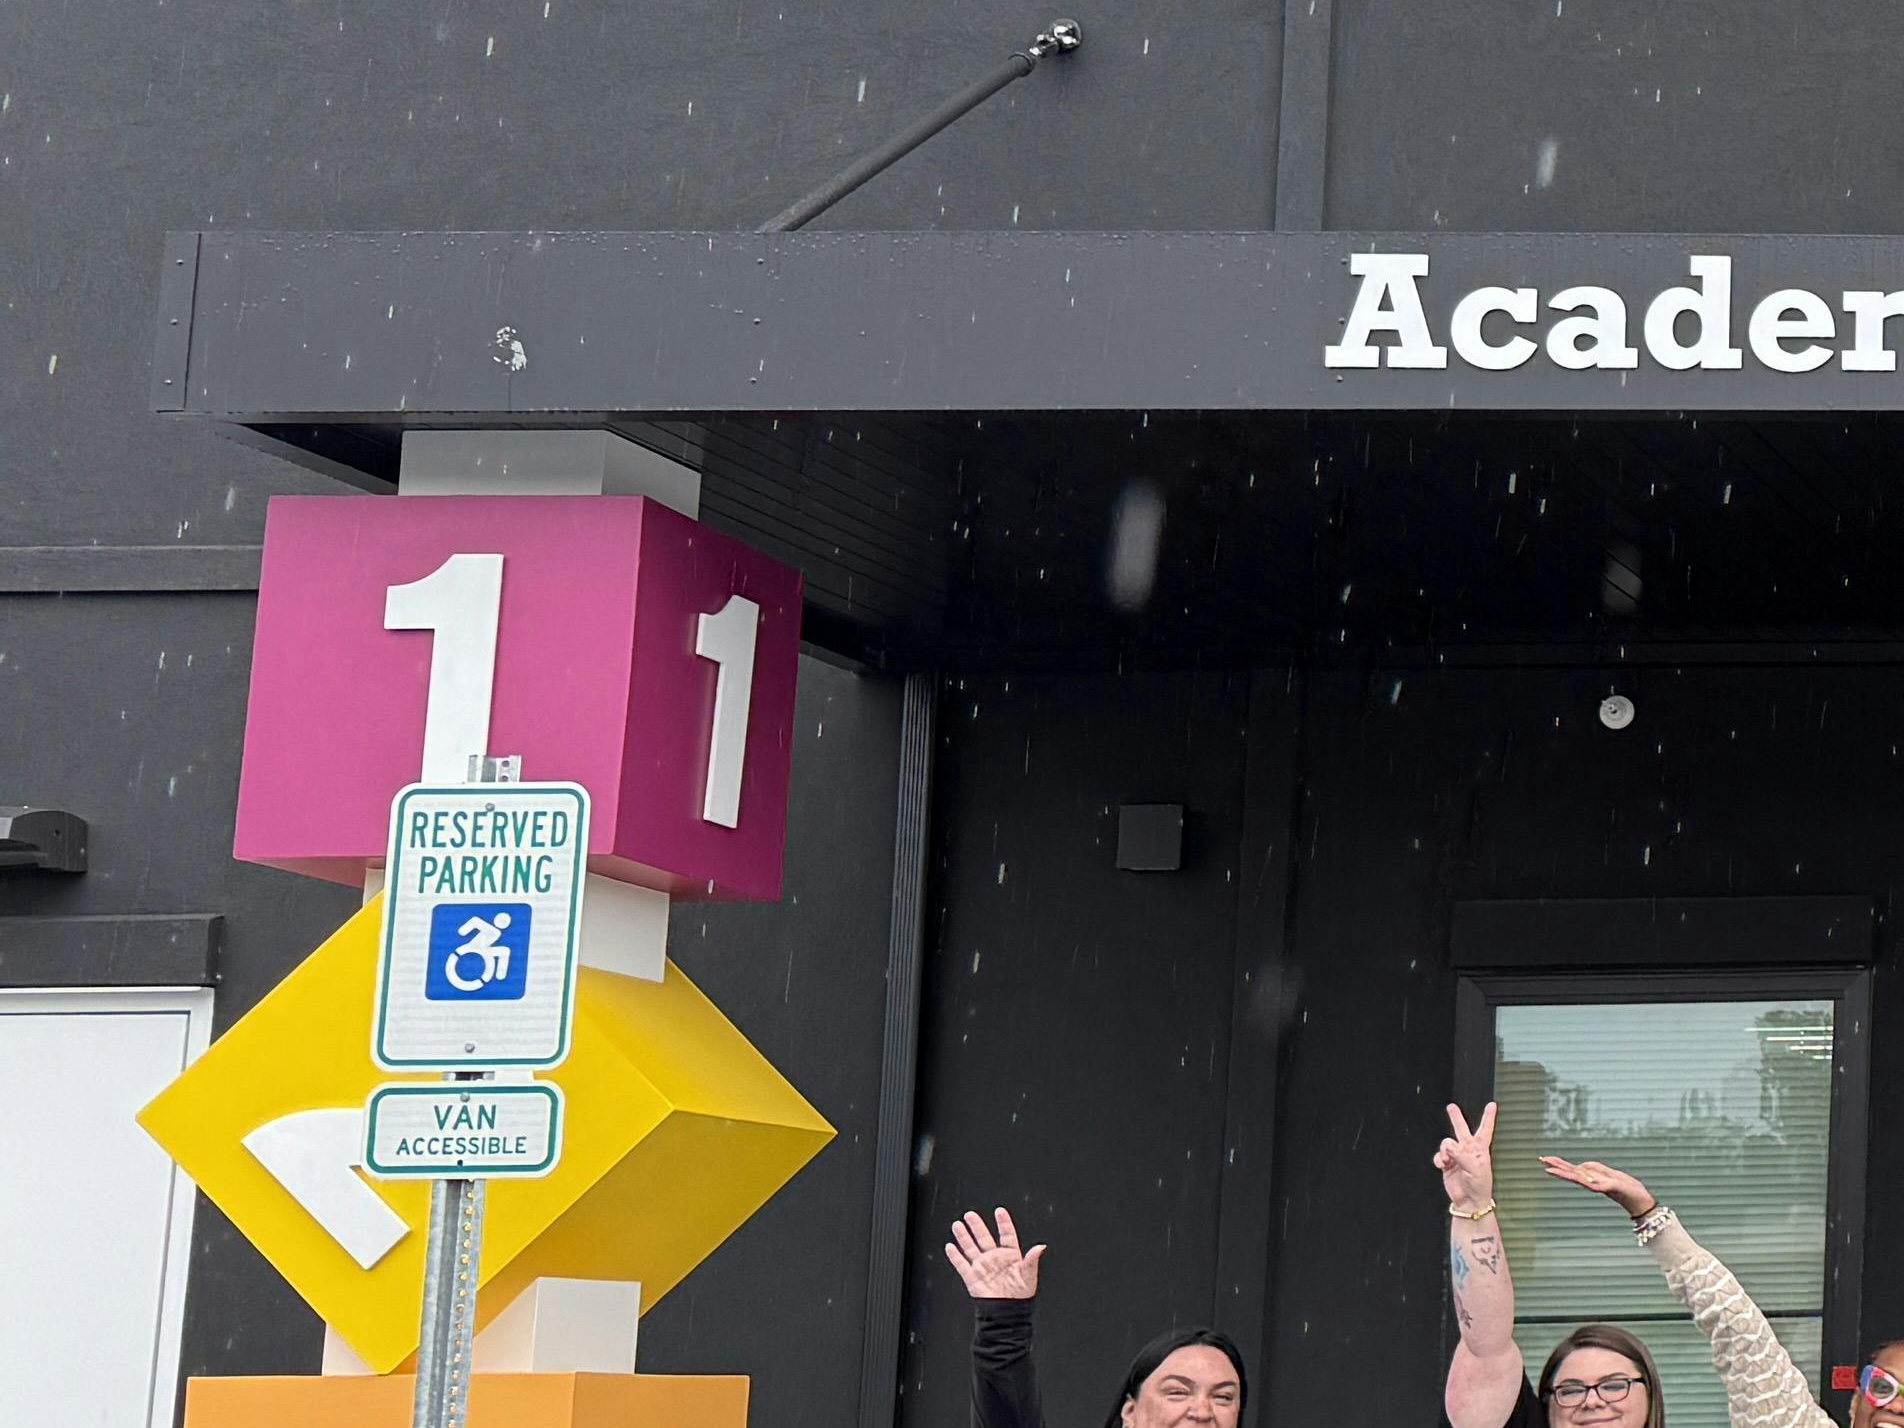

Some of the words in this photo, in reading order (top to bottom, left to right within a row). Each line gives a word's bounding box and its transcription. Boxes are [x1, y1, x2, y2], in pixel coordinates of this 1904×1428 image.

[383, 551, 505, 785] 1
[695, 594, 760, 829] 1
[409, 810, 570, 849] RESERVED
[417, 854, 554, 895] PARKING
[432, 1103, 497, 1131] VAN
[395, 1135, 528, 1156] ACCESSIBLE
